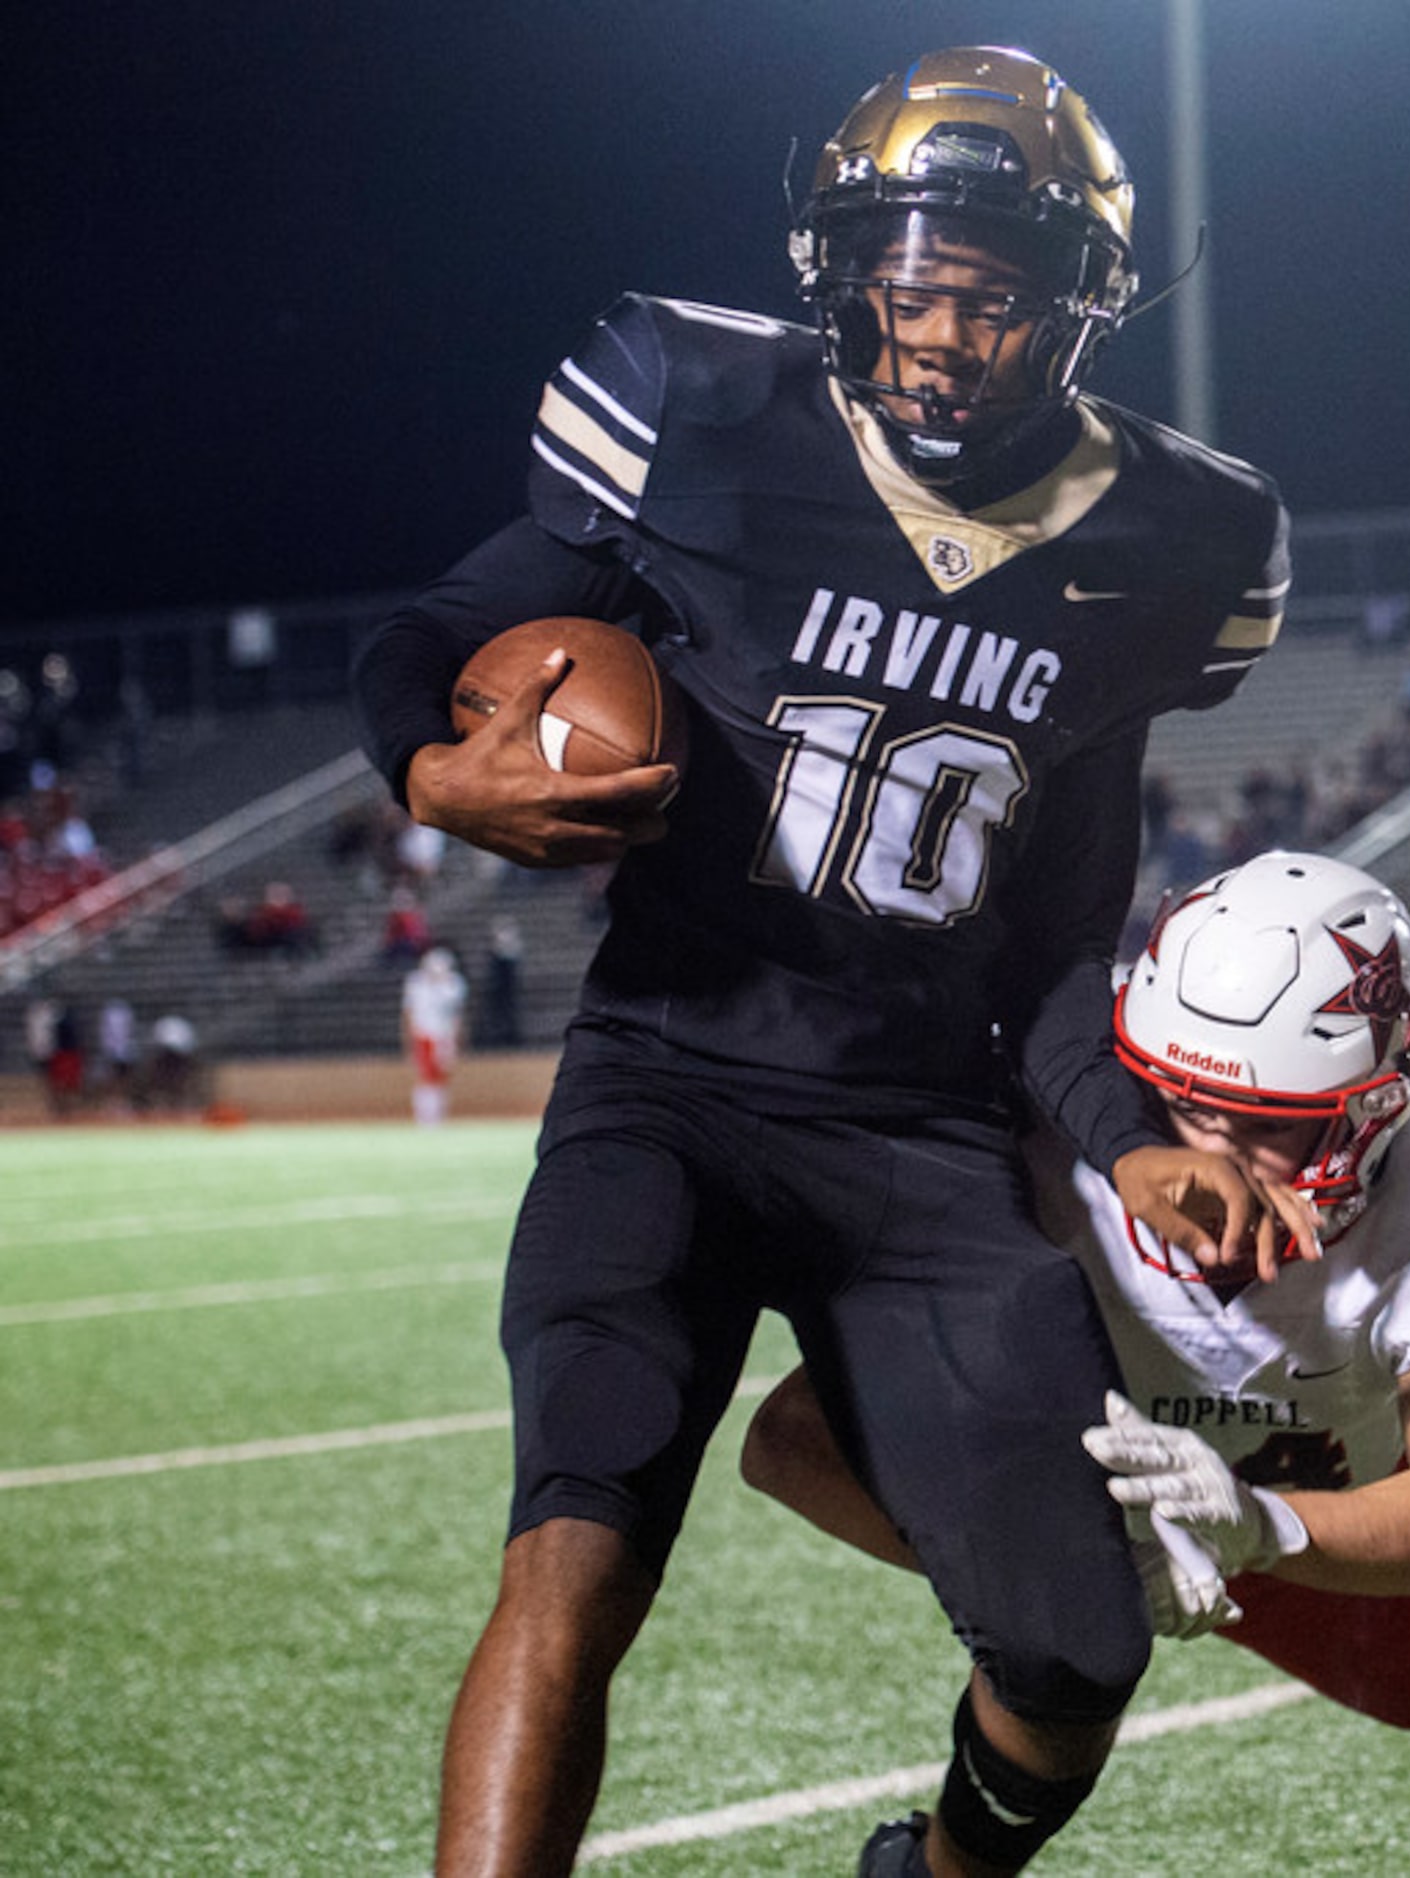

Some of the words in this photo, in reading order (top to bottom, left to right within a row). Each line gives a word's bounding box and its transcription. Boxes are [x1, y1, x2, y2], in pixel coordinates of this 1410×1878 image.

[791, 587, 1062, 724] IRVING
[749, 695, 1030, 930] 10
[1166, 1043, 1242, 1078] Riddell
[1150, 1394, 1309, 1428] COPPELL
